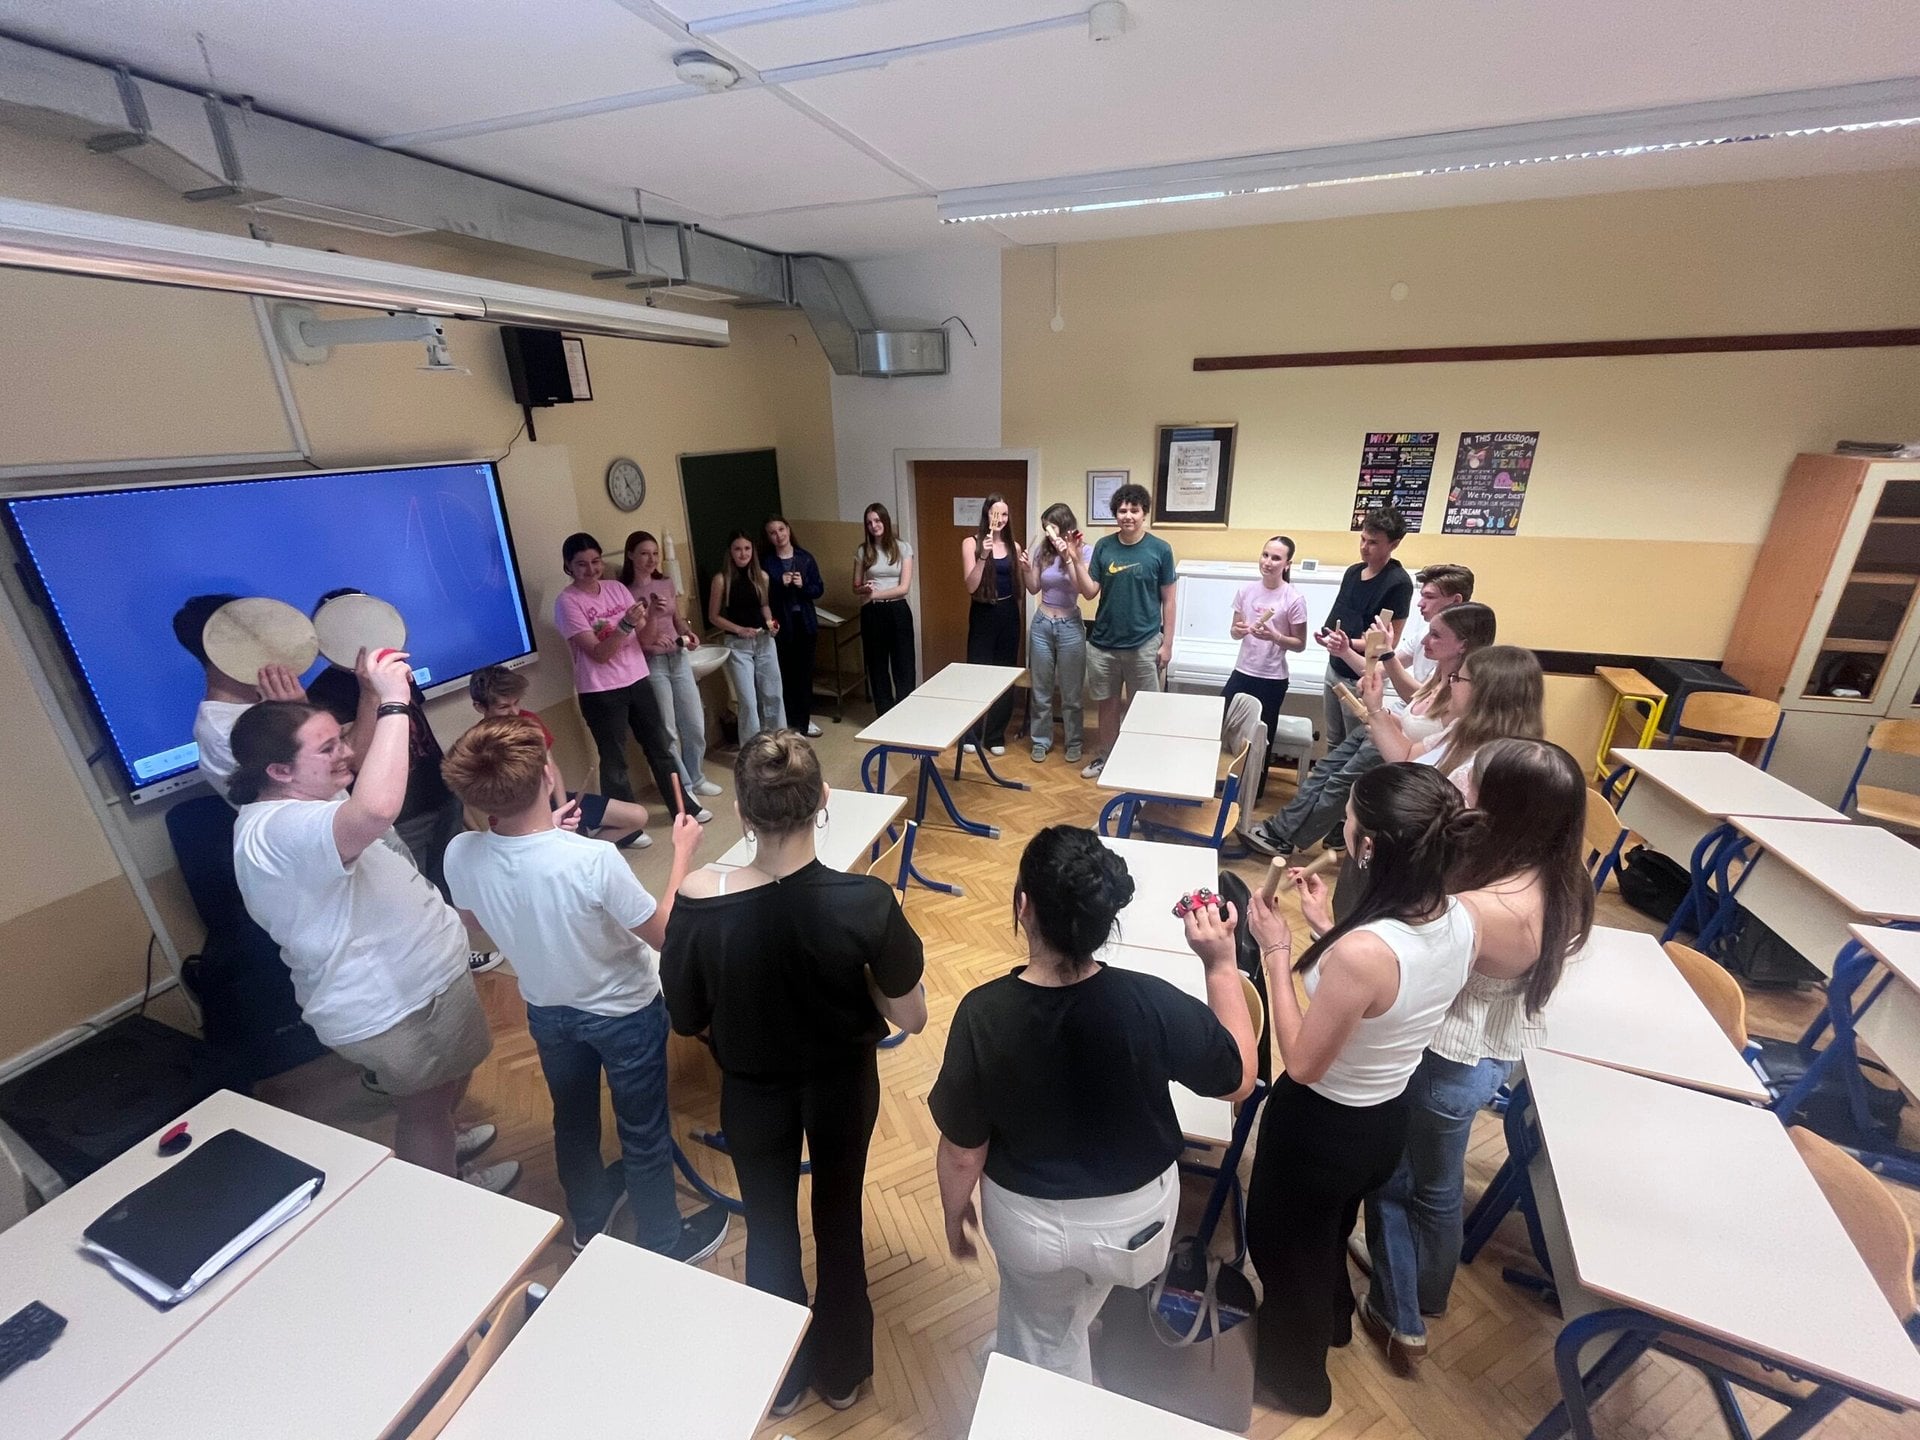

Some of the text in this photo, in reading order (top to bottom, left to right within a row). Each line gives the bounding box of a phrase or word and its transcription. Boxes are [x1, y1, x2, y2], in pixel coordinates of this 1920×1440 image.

[1370, 434, 1434, 444] WHY MUSIC?
[1475, 434, 1492, 443] THIS
[1494, 433, 1537, 446] CLASSROOM
[1492, 458, 1532, 468] TEAM
[1481, 492, 1492, 500] try
[1446, 515, 1463, 525] BIG!
